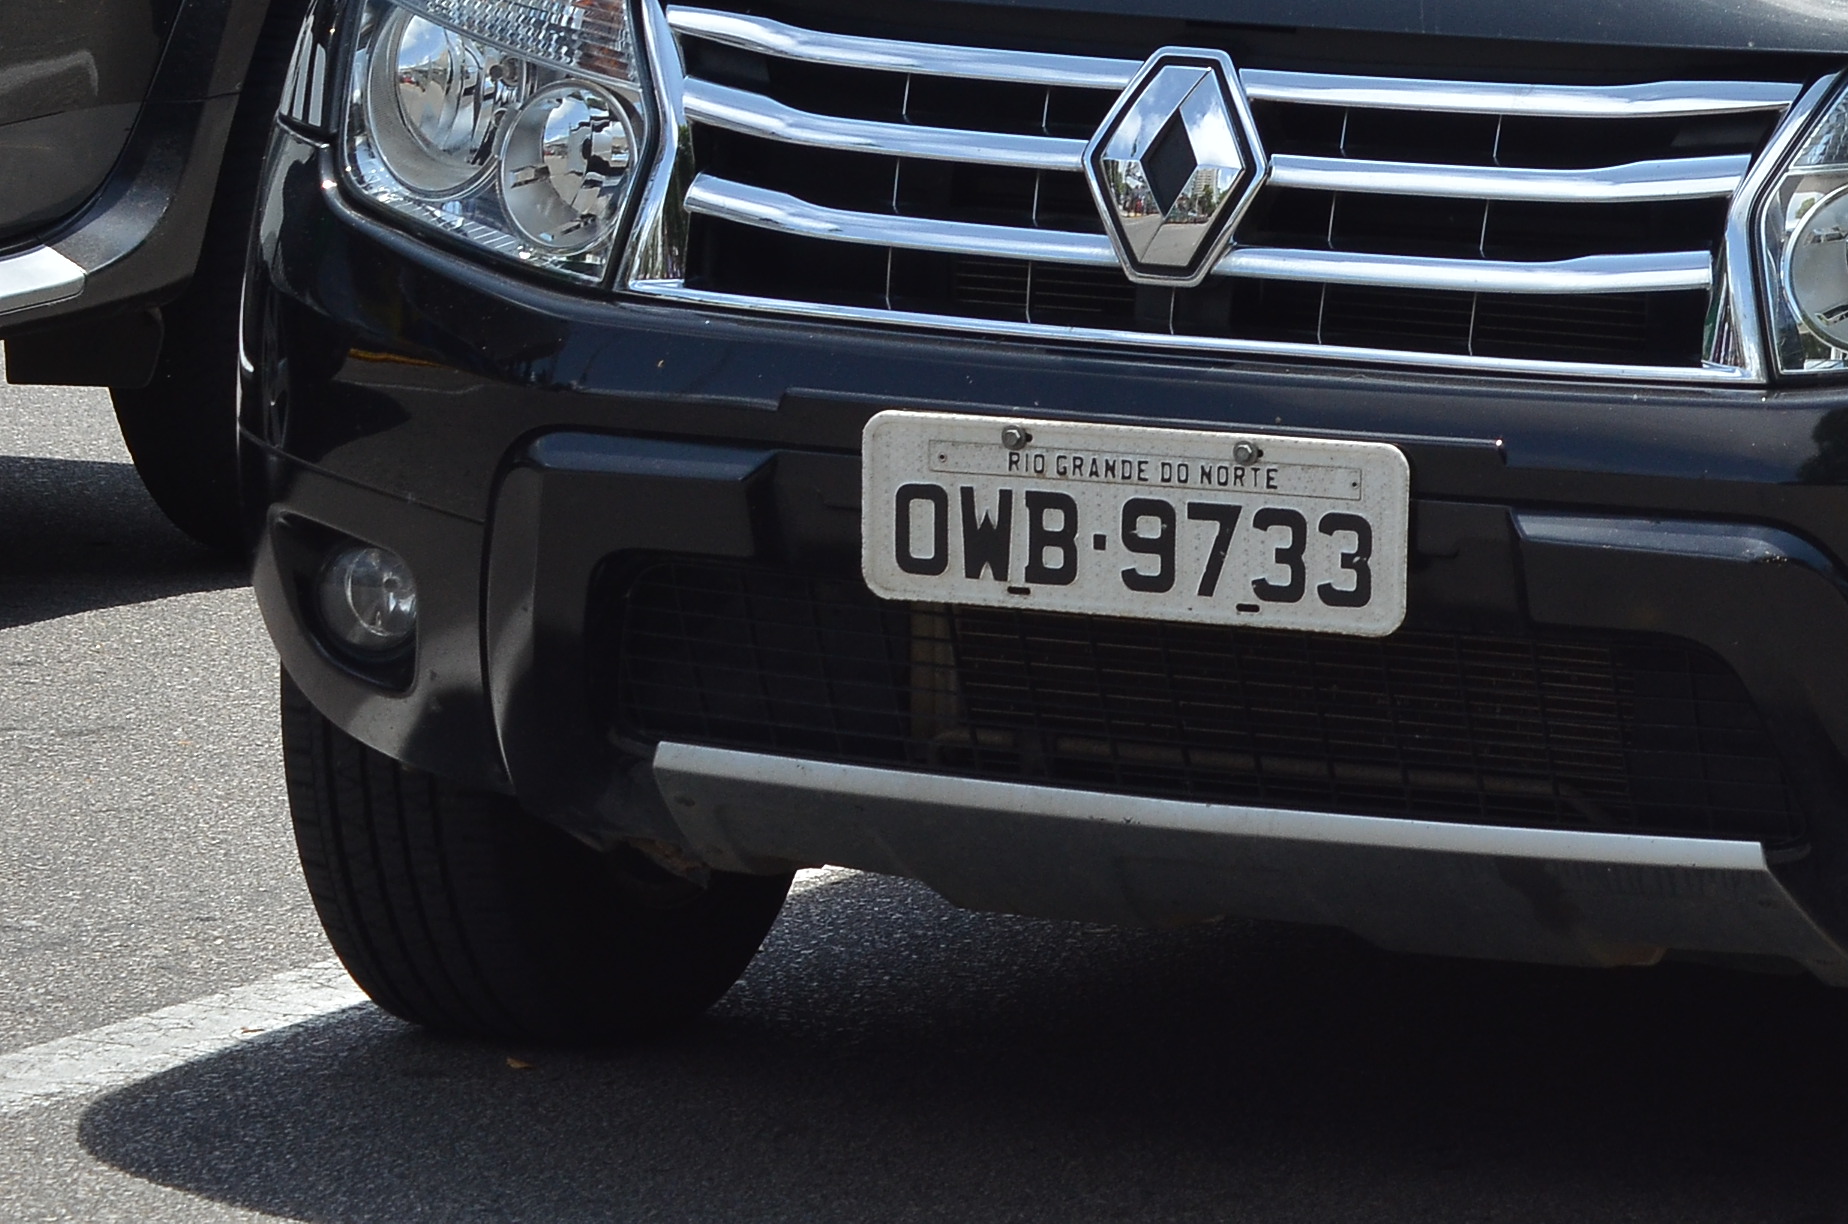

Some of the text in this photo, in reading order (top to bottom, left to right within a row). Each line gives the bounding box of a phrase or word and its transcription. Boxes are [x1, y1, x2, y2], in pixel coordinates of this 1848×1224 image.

[1008, 452, 1280, 491] RIO GRANDE DO NORTE
